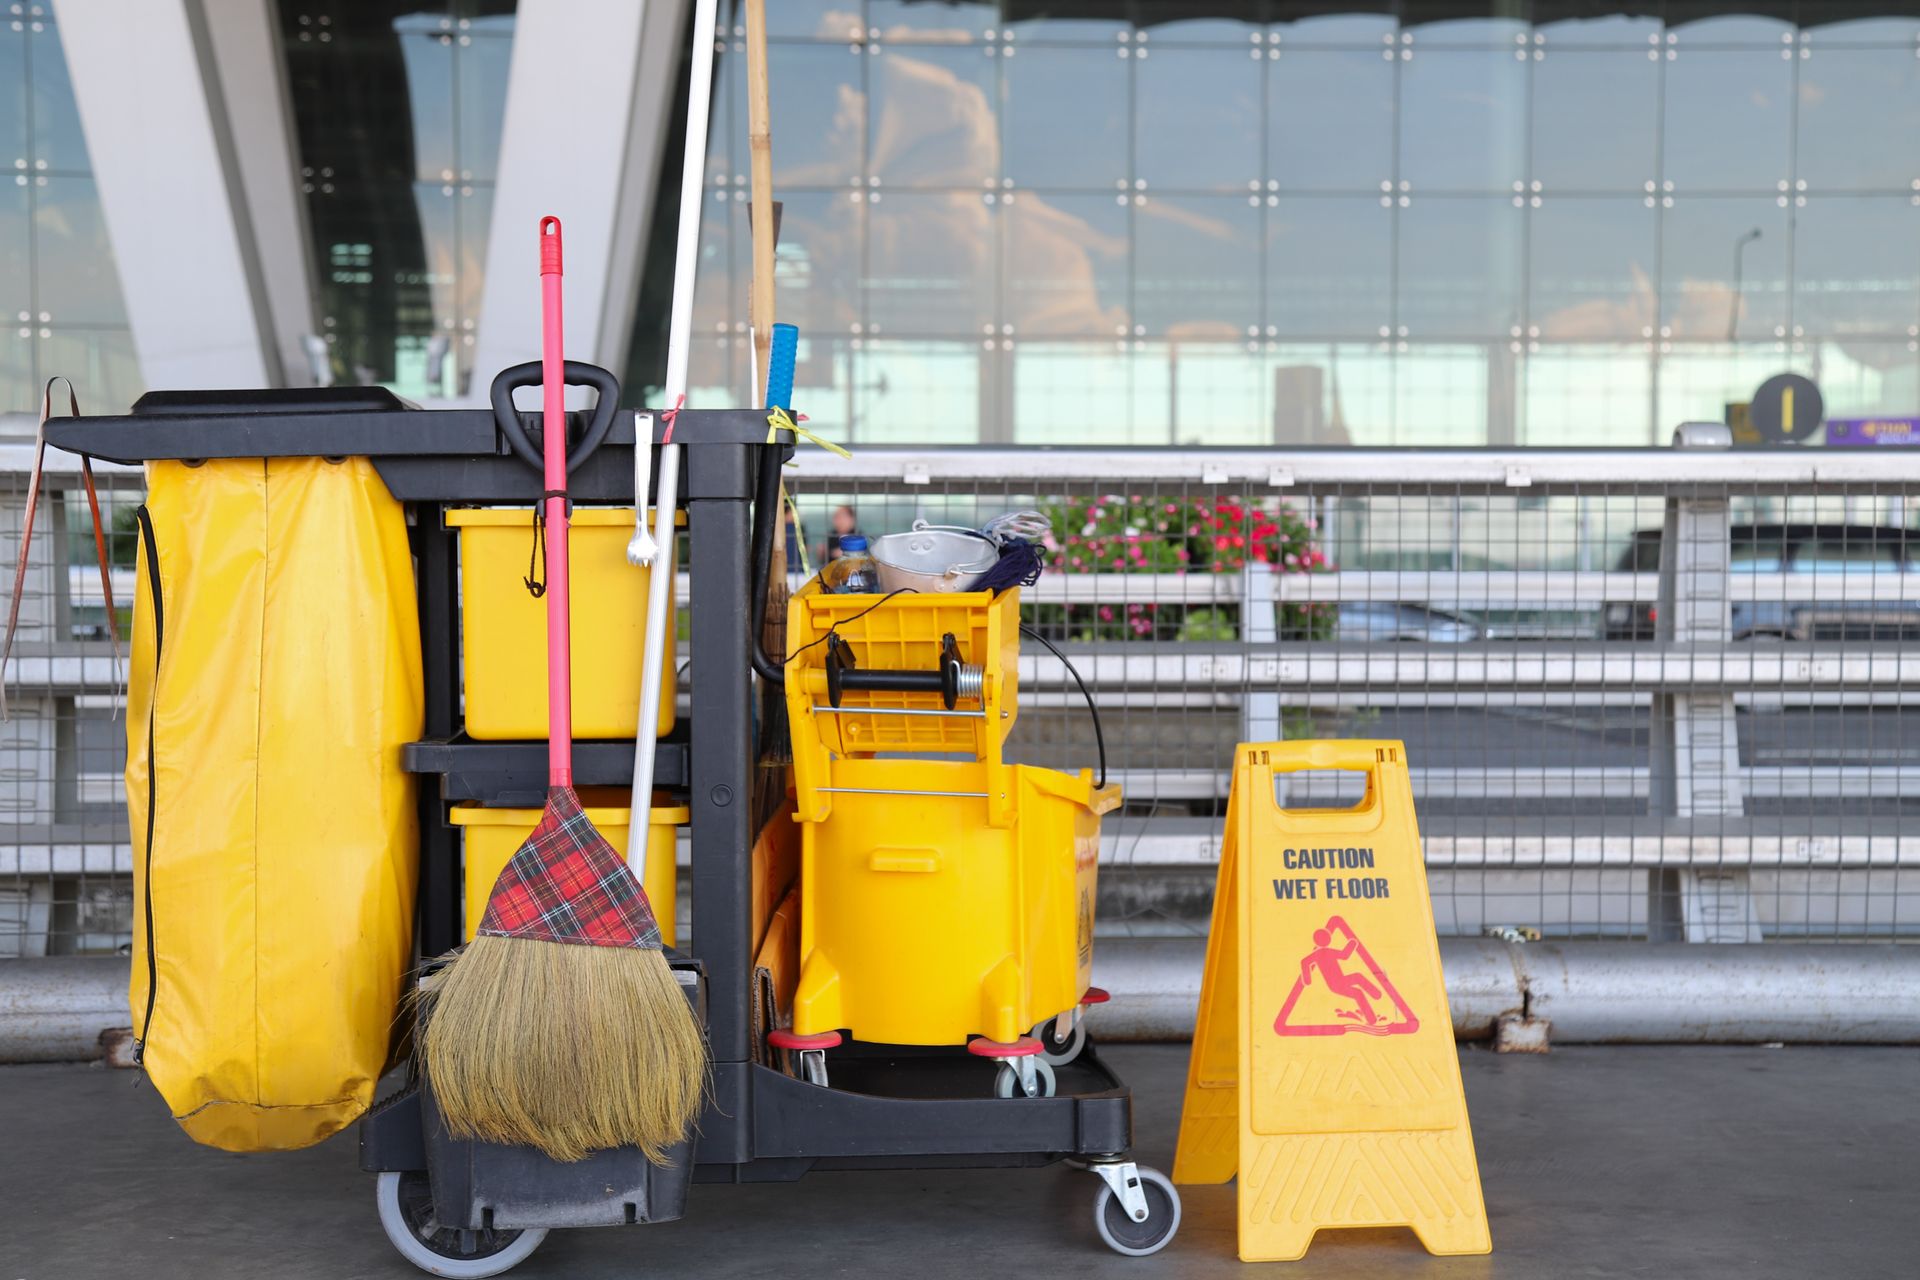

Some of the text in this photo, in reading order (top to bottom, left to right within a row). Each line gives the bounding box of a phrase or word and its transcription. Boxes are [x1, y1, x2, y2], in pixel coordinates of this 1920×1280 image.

[1283, 848, 1375, 869] CAUTION
[1272, 878, 1389, 900] WET FLOOR
